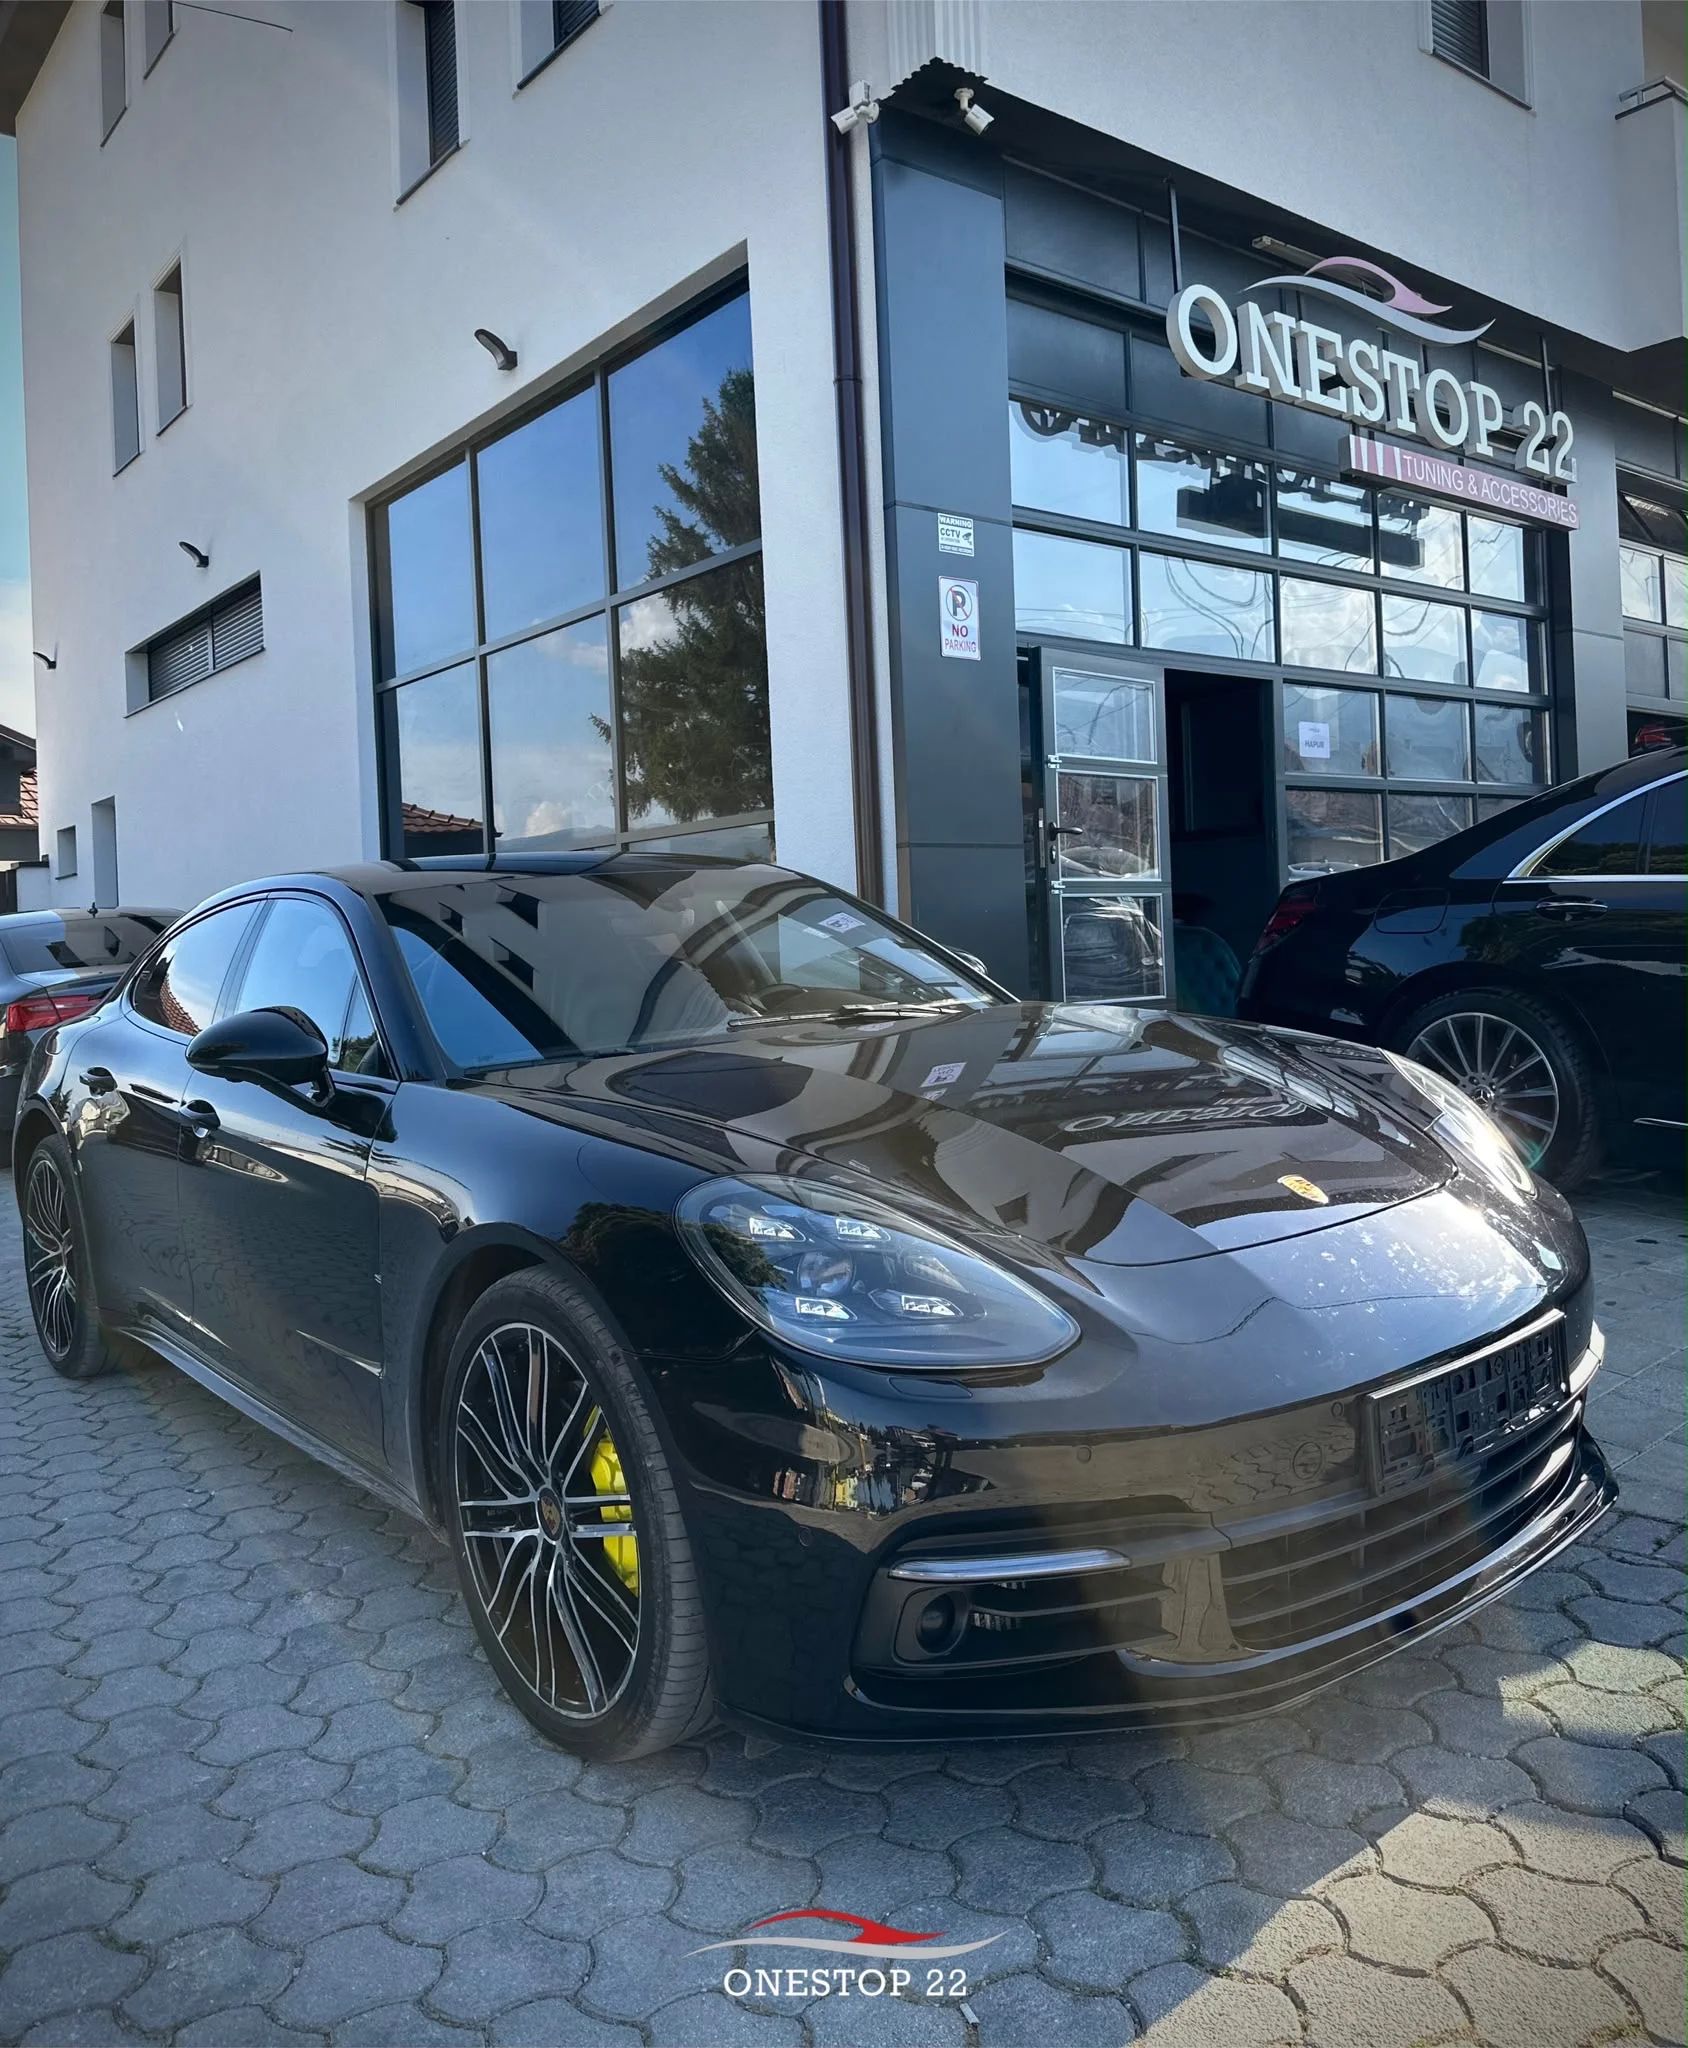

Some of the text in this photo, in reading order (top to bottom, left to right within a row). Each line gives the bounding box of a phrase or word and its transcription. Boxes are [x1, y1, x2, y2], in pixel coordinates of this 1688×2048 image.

[1166, 284, 1577, 484] ONESTOP 22
[1402, 454, 1577, 524] TUNING & ACCESSORIES
[940, 516, 973, 529] WARNING
[940, 527, 961, 539] CCTV
[952, 624, 968, 637] NO
[944, 638, 977, 652] PARKING
